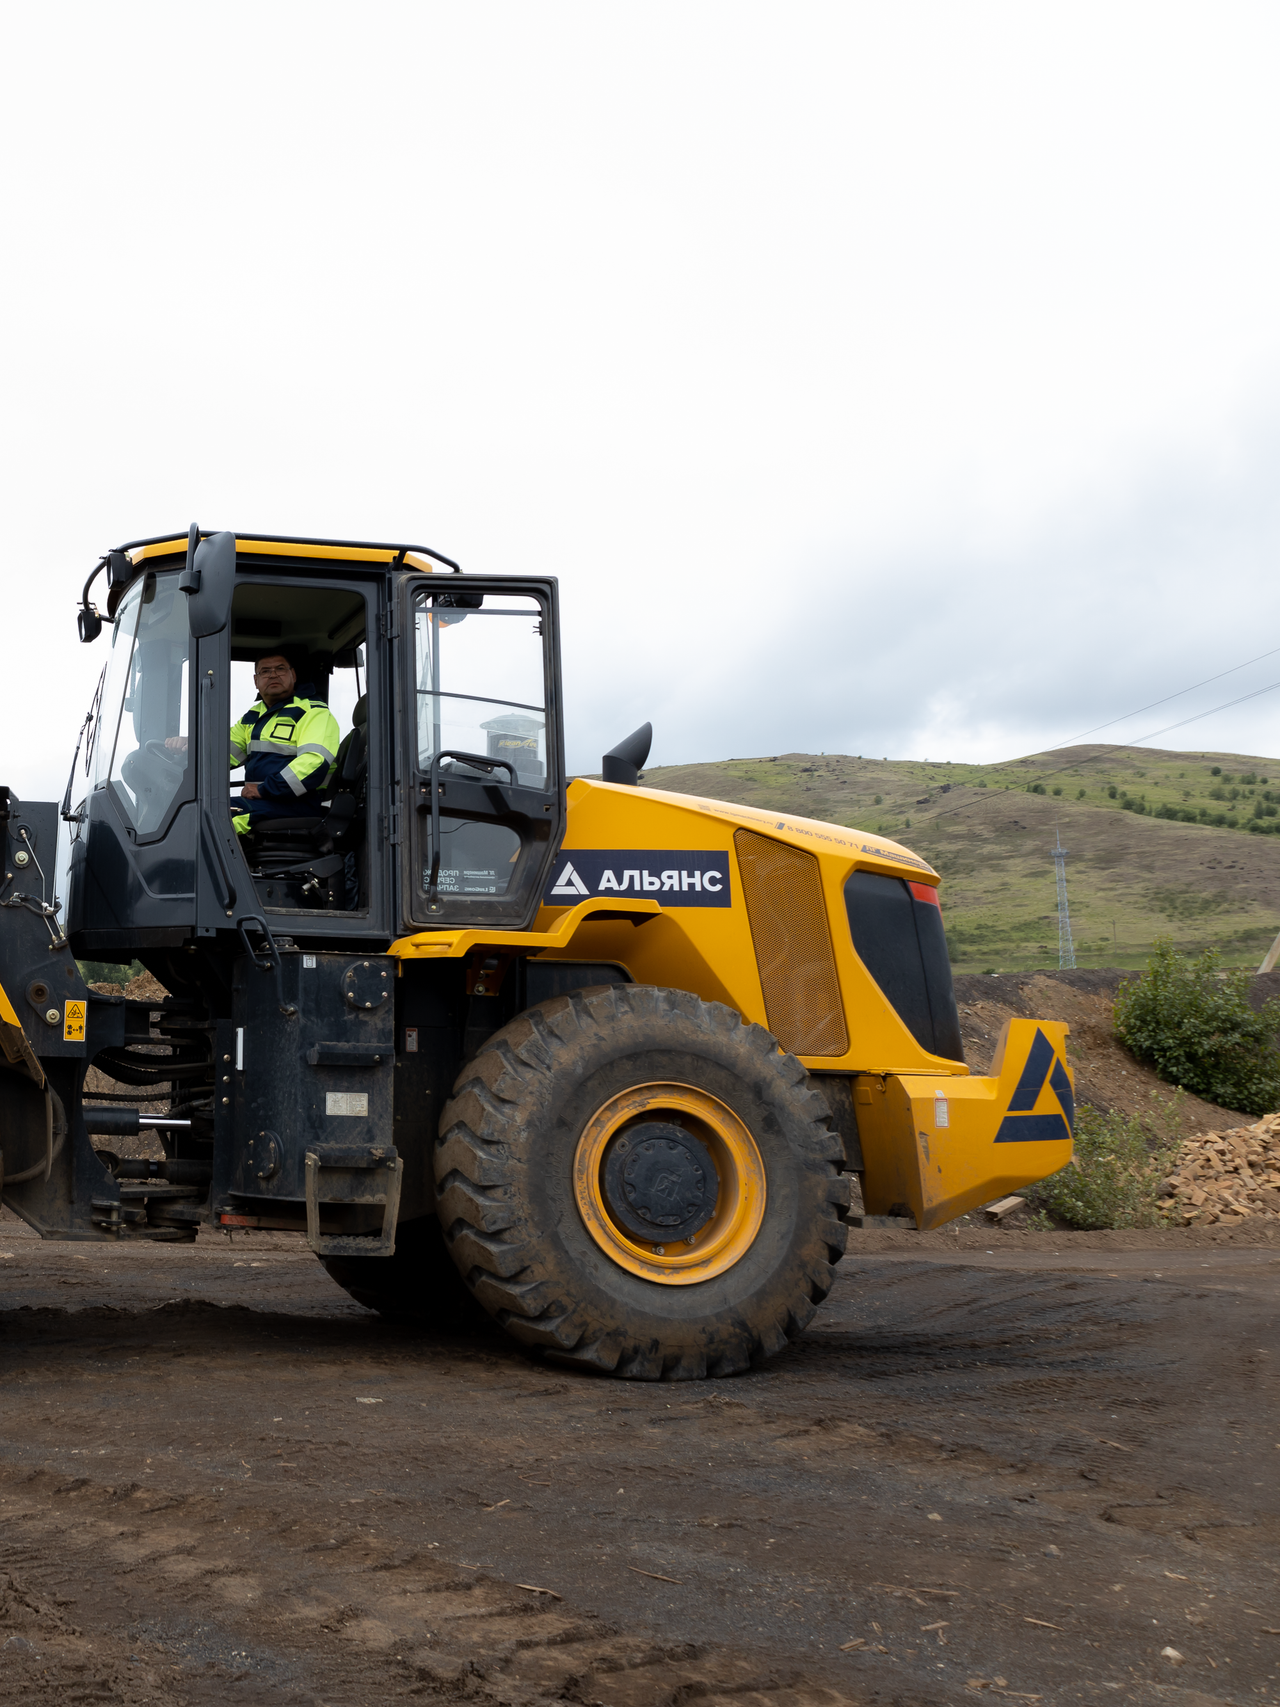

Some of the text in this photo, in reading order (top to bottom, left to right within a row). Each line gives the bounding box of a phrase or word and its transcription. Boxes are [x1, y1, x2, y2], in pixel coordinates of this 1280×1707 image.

[795, 827, 813, 837] 800
[814, 832, 833, 842] 555
[834, 837, 847, 846] 50
[847, 841, 859, 850] 71
[598, 869, 723, 892] АЛЬЯНС
